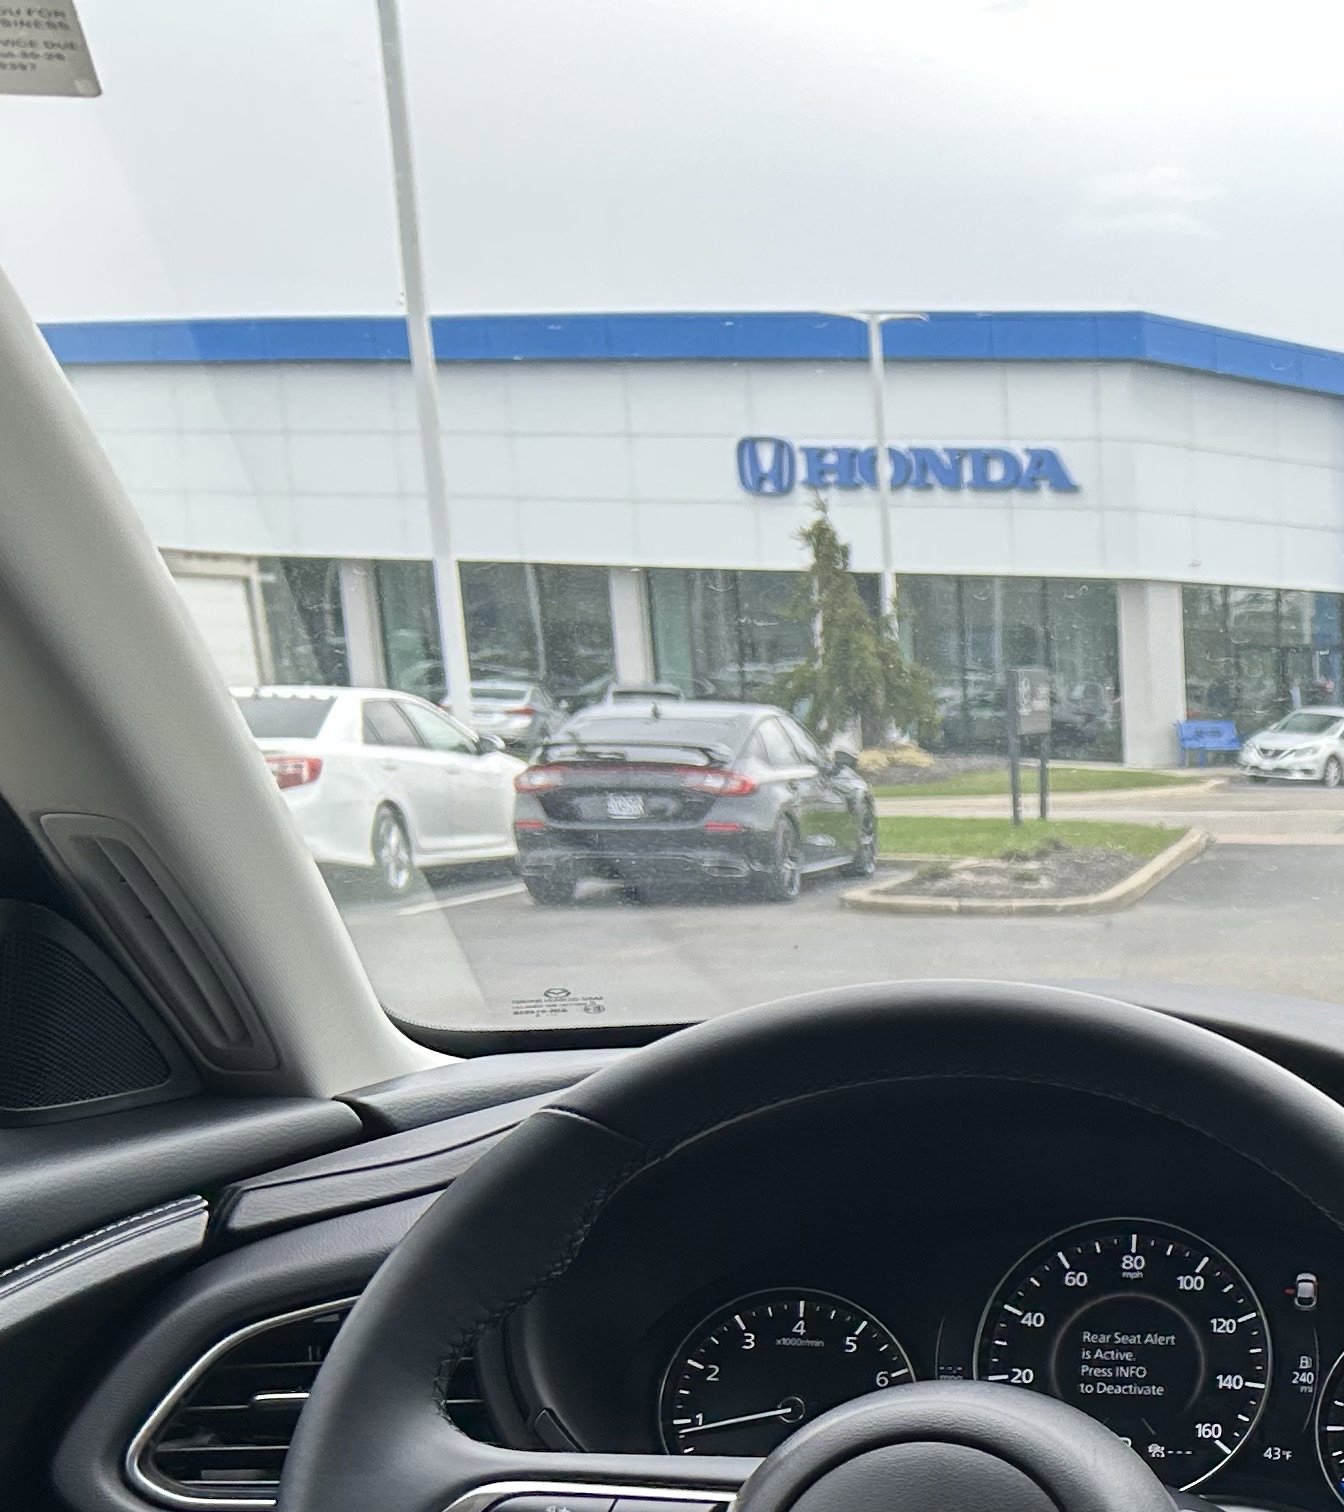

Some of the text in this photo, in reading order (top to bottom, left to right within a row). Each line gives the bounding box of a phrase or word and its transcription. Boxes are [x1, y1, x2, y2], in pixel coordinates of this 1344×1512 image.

[801, 447, 1081, 493] HONDA
[1121, 1255, 1146, 1271] 80
[1064, 1271, 1088, 1287] 60
[1121, 1270, 1145, 1280] mph
[1176, 1275, 1205, 1291] 100
[792, 1320, 806, 1335] 4
[1020, 1312, 1045, 1328] 40
[1210, 1318, 1237, 1334] 120
[742, 1332, 755, 1350] 3
[844, 1336, 858, 1353] 5
[1082, 1331, 1176, 1347] Rear Seat Alert
[1081, 1349, 1136, 1362] is Active.
[706, 1365, 720, 1381] 2
[875, 1371, 889, 1388] 6
[1011, 1368, 1034, 1384] 20
[1080, 1365, 1147, 1379] Press INFO
[1291, 1372, 1315, 1385] 240
[1079, 1383, 1164, 1397] to Deactivate
[1216, 1375, 1244, 1390] 140
[695, 1413, 704, 1426] 1
[1195, 1423, 1222, 1439] 160
